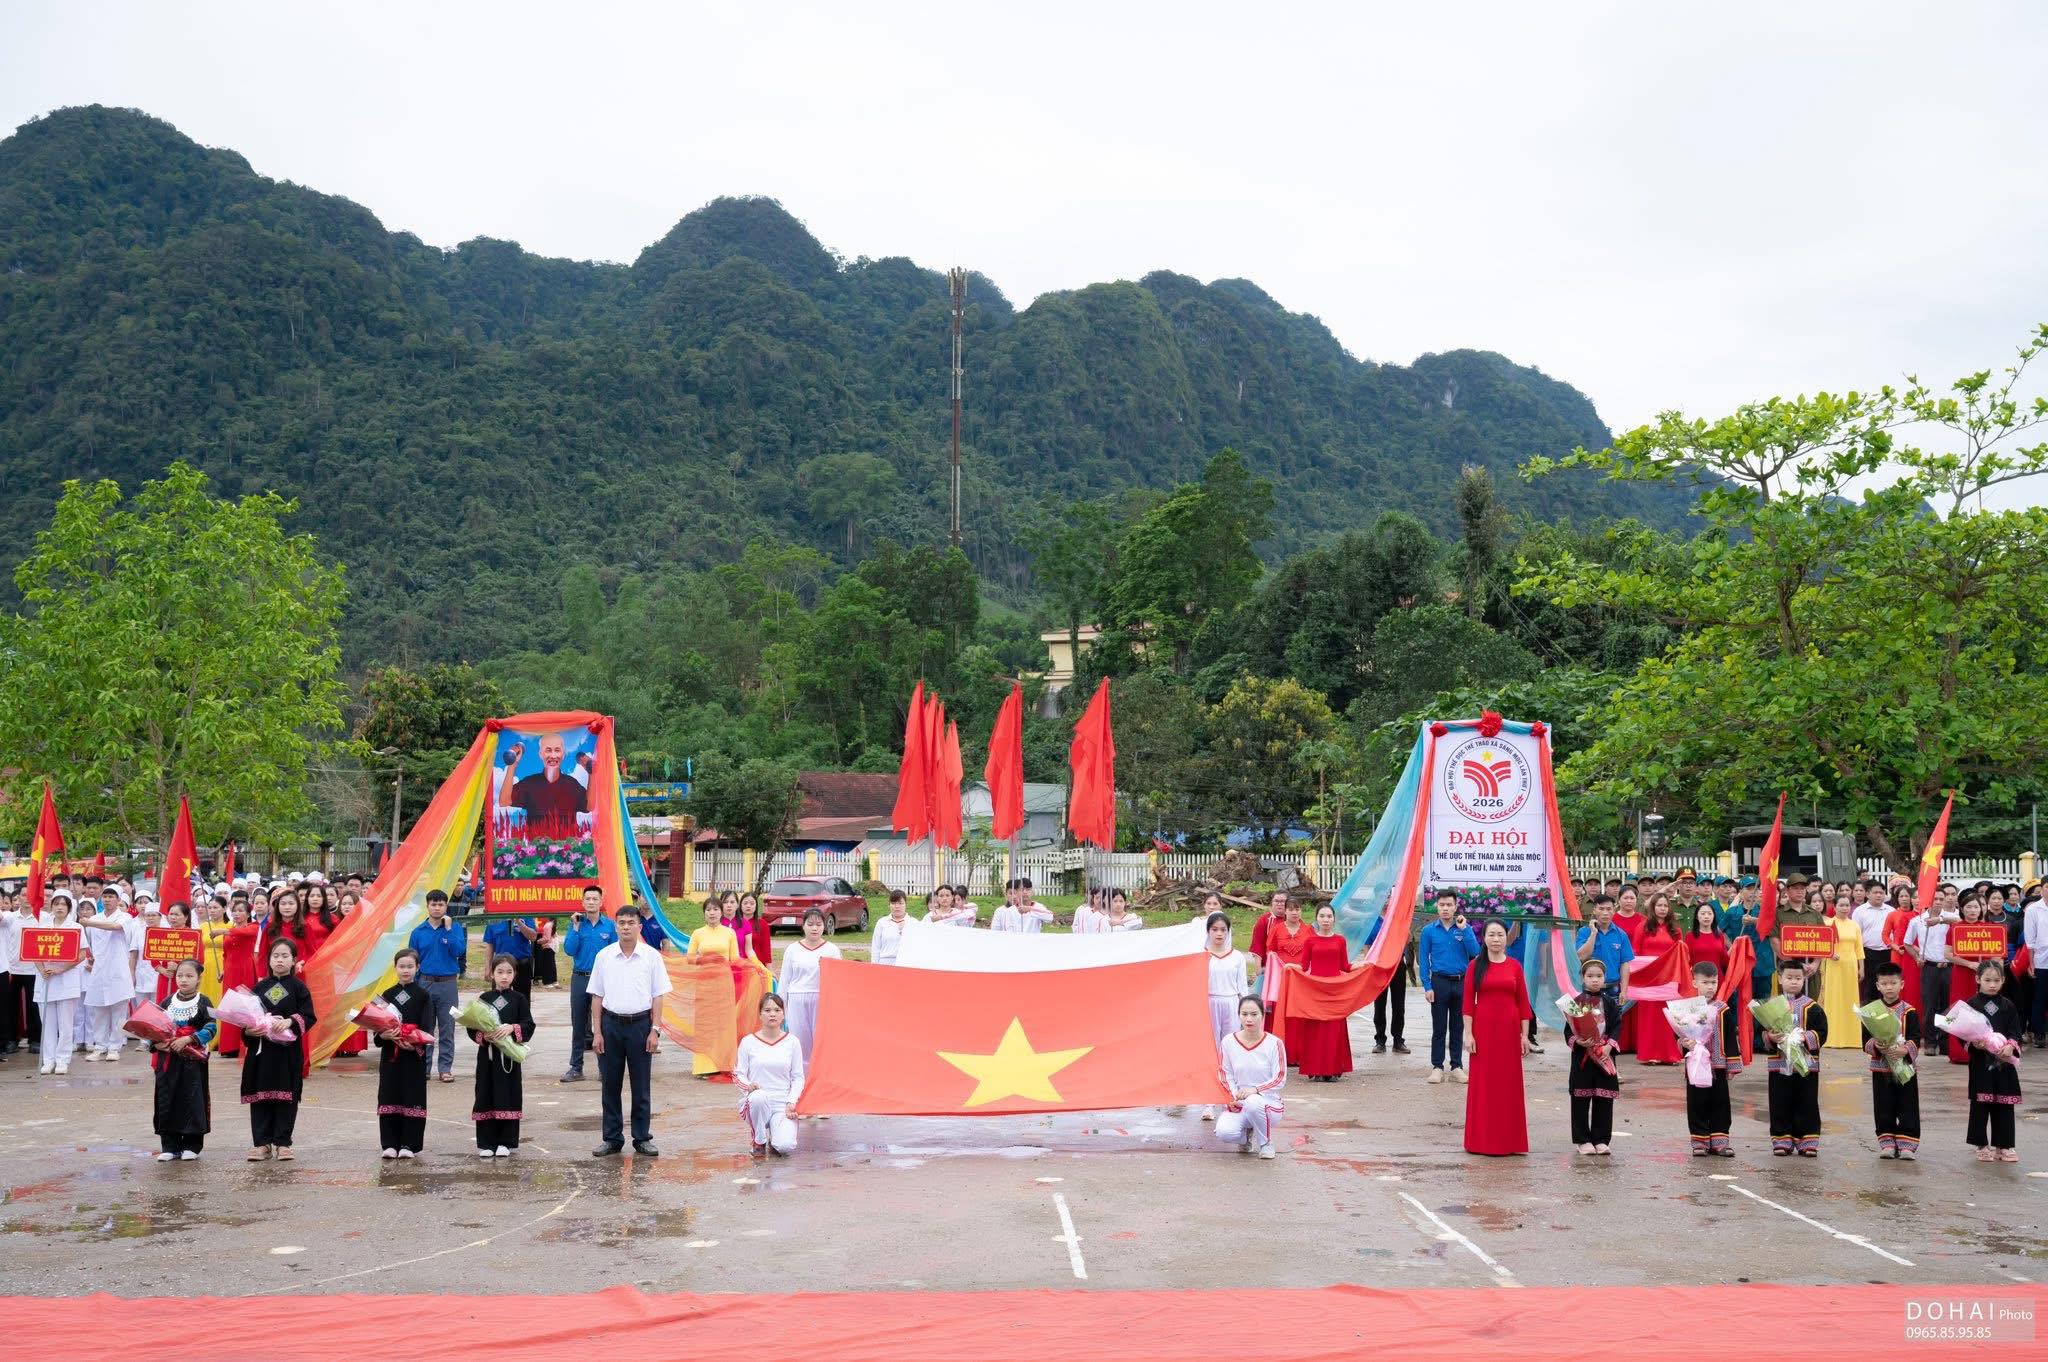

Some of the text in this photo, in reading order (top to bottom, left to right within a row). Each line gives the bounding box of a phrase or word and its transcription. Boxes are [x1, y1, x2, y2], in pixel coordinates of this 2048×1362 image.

[1473, 799, 1503, 807] 2026
[1449, 827, 1527, 848] ĐẠI HỘI
[1436, 850, 1448, 860] THỂ
[1449, 852, 1463, 861] DỤC
[1464, 851, 1476, 860] THỂ
[1496, 851, 1504, 860] XÃ
[1526, 852, 1541, 862] MỘC
[1489, 863, 1504, 871] NĂM
[491, 885, 583, 904] TỰ TÔI NGÀY NÀO CŨN
[37, 933, 64, 942] KHỐI
[1794, 929, 1820, 938] KHỐI
[1967, 929, 1991, 938] KHỐI
[37, 943, 61, 956] Y TẾ
[1957, 939, 2002, 953] GIÁO DỤC
